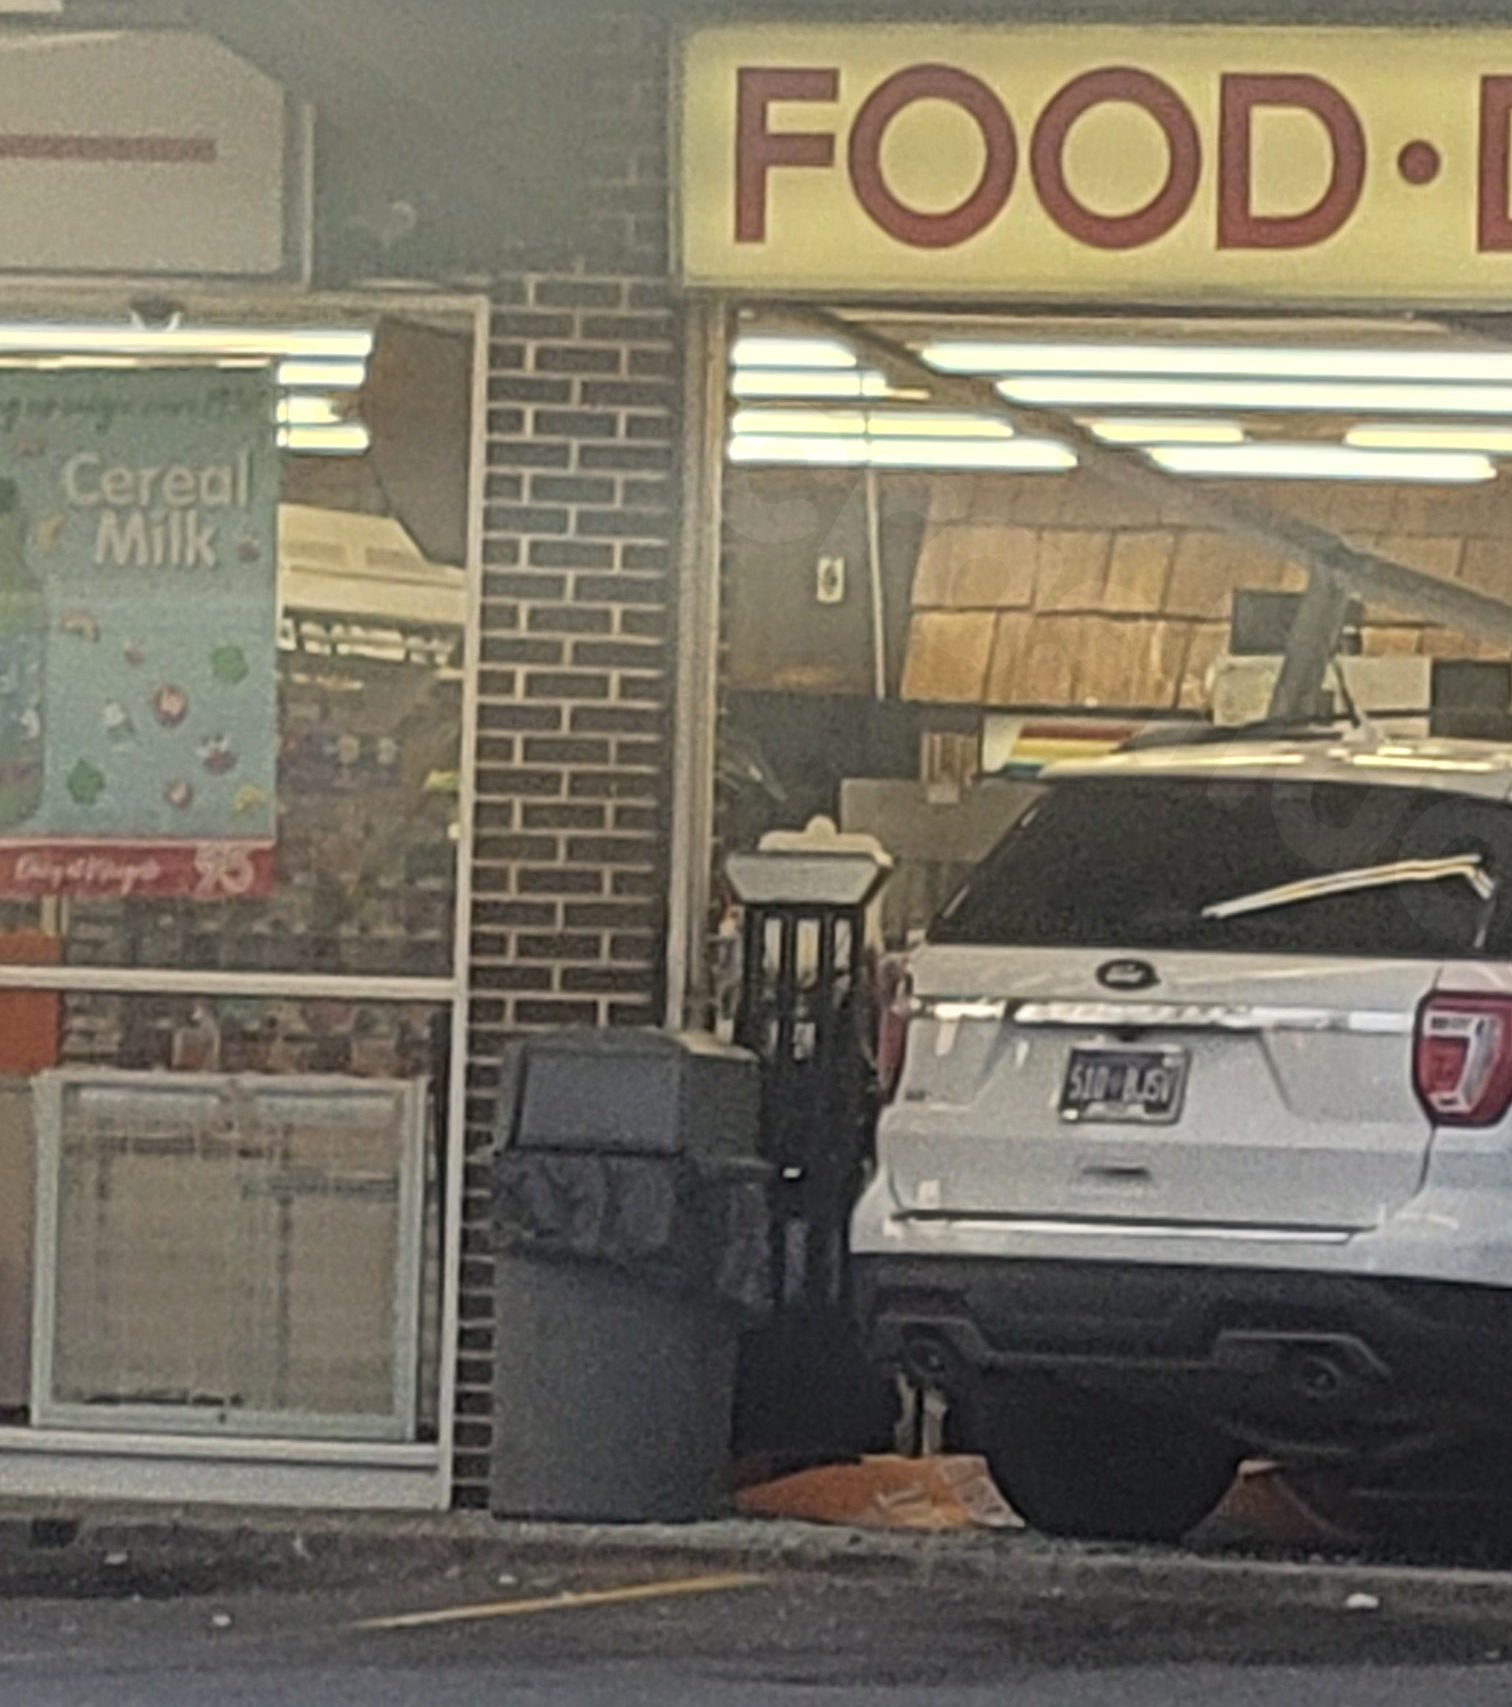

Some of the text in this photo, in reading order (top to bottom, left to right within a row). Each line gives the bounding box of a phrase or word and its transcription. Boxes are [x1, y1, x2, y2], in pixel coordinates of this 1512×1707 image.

[734, 62, 1367, 251] FOOD
[63, 448, 252, 507] Cereal
[94, 509, 218, 567] Milk
